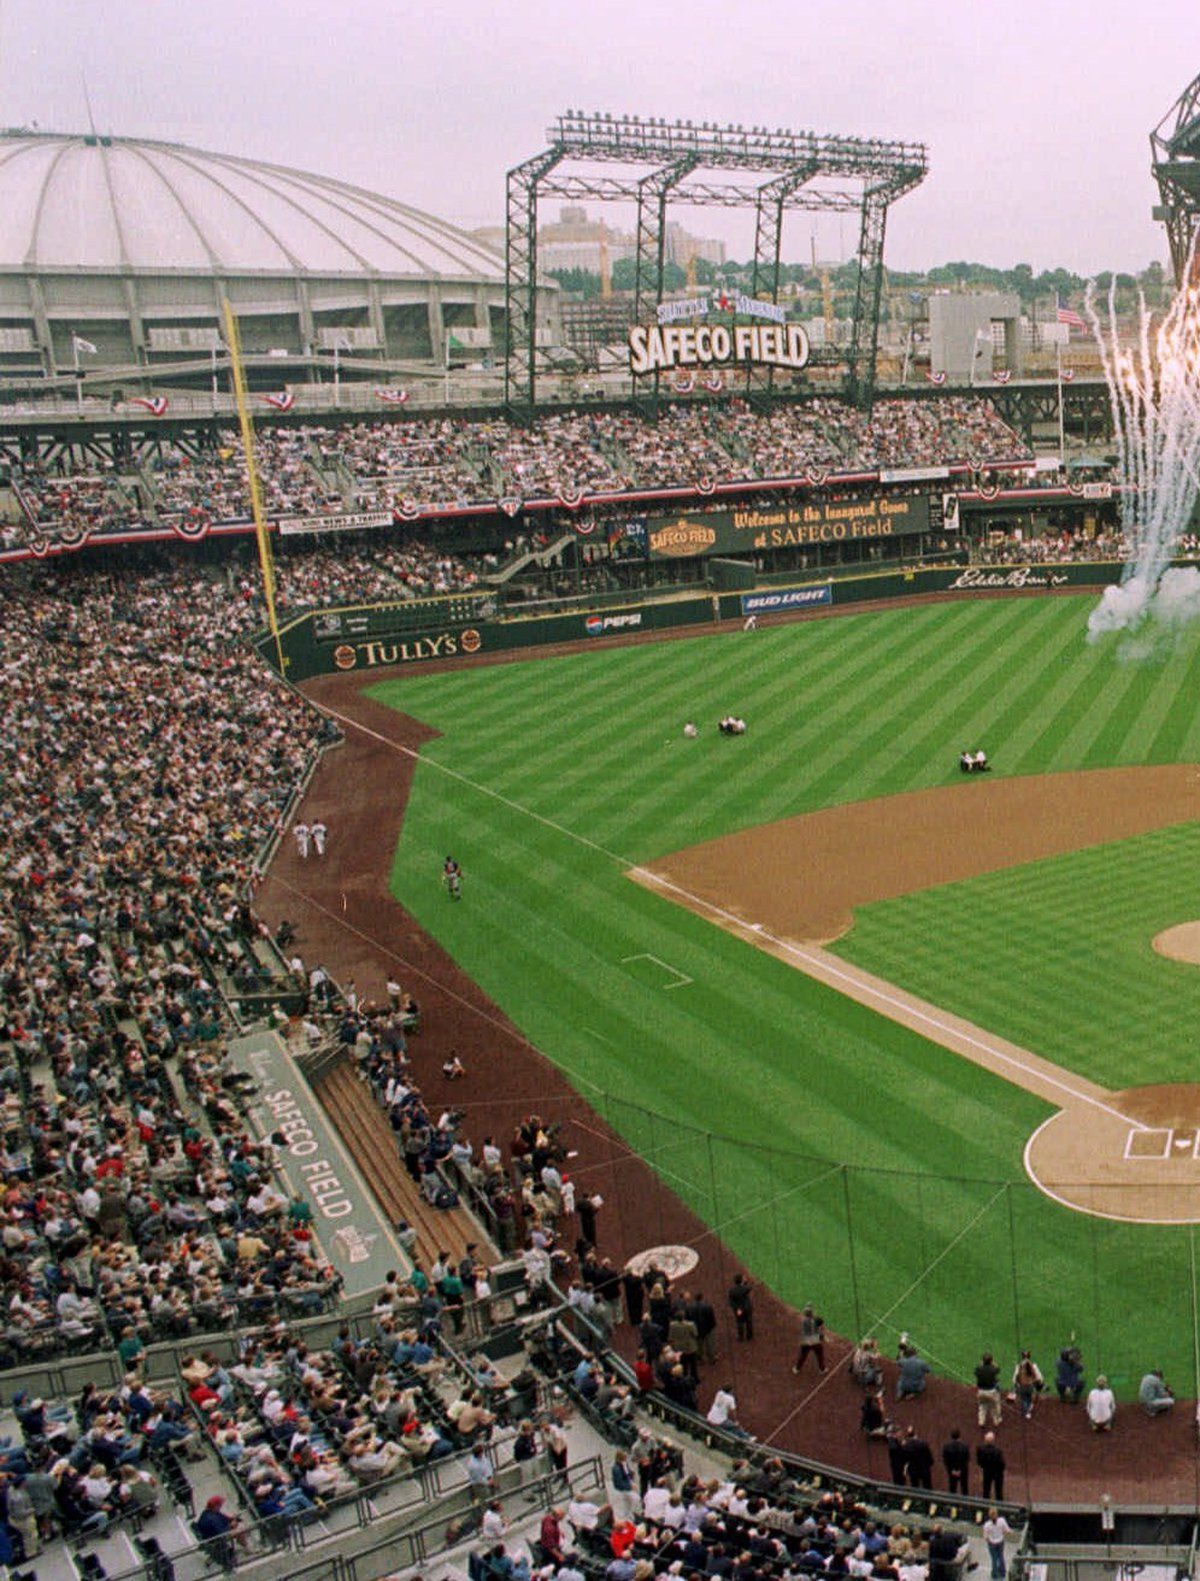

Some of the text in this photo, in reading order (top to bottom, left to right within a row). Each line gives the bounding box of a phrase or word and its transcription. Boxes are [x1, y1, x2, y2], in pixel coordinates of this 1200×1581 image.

[630, 325, 809, 375] SAFECO FIELD
[734, 512, 786, 530] Welcome
[789, 509, 801, 522] to
[803, 506, 822, 521] the
[824, 500, 876, 520] Inaugural
[650, 522, 689, 551] SAFECO
[689, 517, 717, 544] FIELD
[754, 517, 893, 548] at SAFECO Field
[948, 567, 1068, 590] Eddie Baur
[747, 590, 825, 609] BUD LIGHT
[603, 613, 641, 630] PEPSI
[356, 633, 457, 666] TULLY'S
[264, 1088, 319, 1157] SAFECO
[300, 1158, 353, 1219] FIELD
